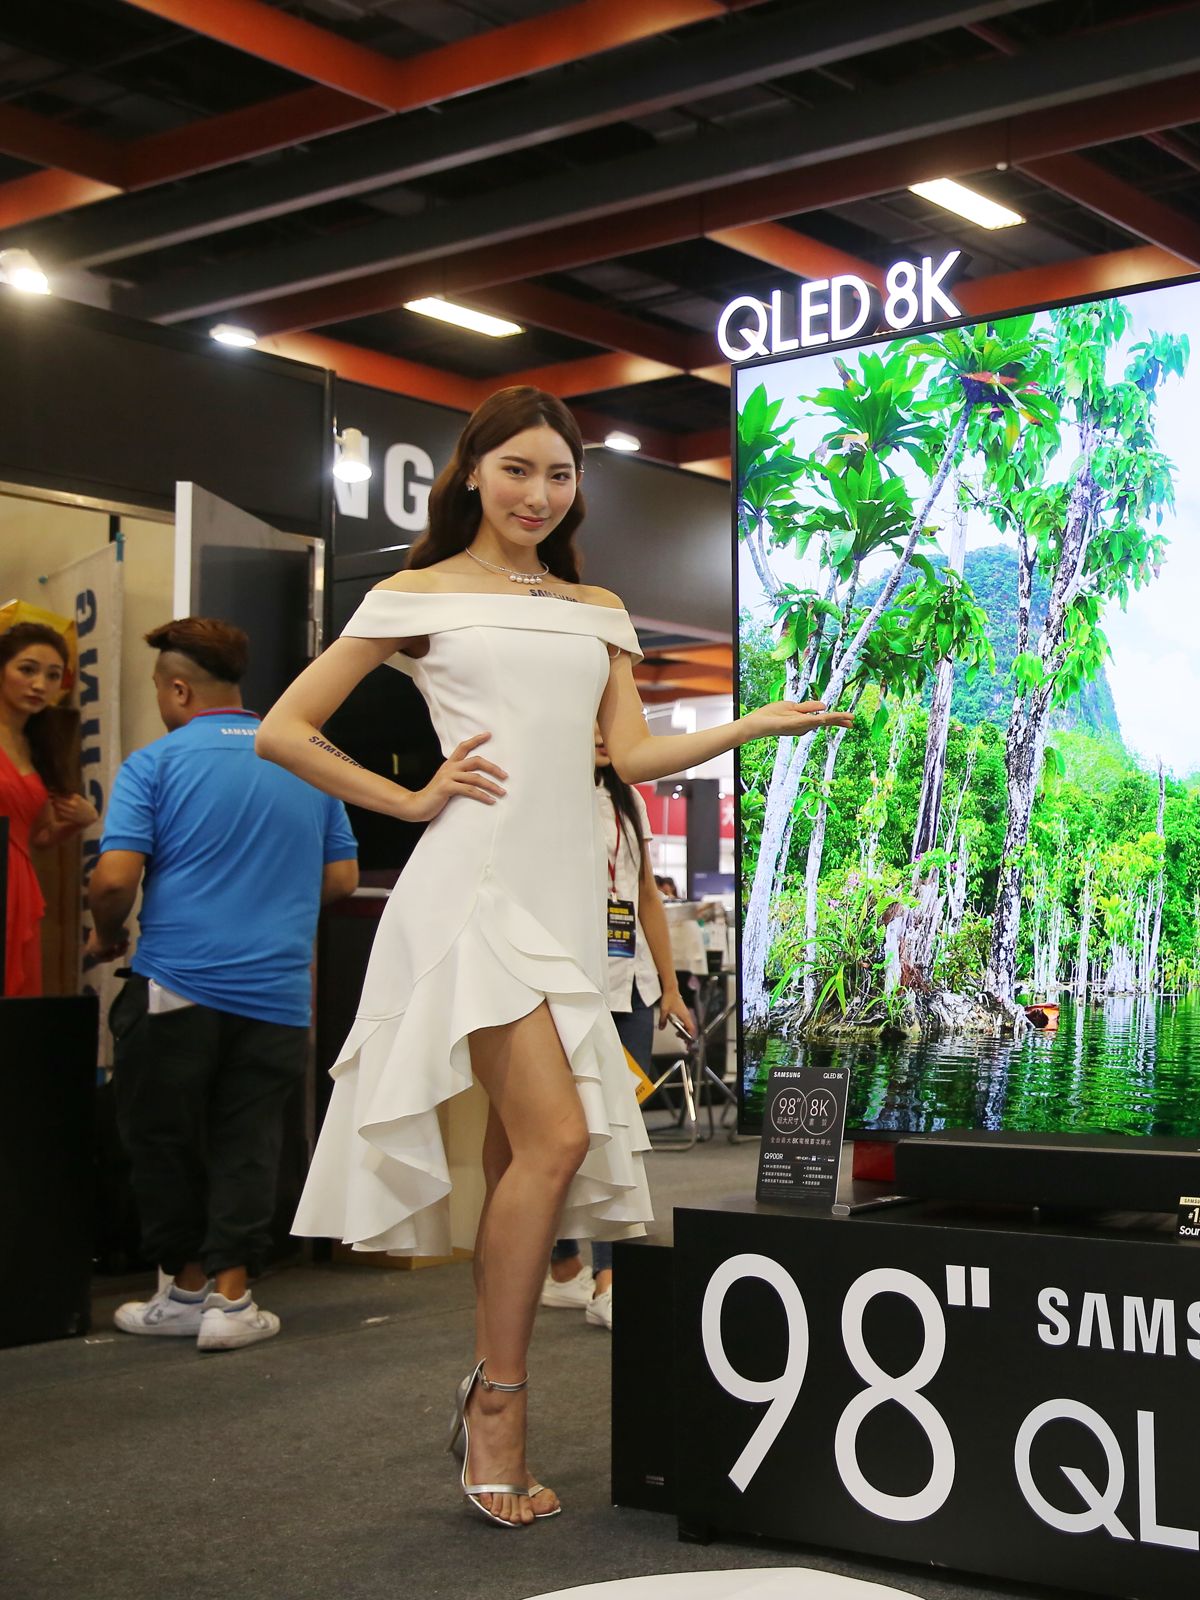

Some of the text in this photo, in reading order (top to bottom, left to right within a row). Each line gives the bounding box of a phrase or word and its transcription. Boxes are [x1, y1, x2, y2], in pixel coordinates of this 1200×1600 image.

[717, 250, 962, 361] QLED 8K
[308, 735, 367, 770] SAMSUN
[773, 1071, 801, 1079] SAMSUNG
[810, 1099, 830, 1117] 8K
